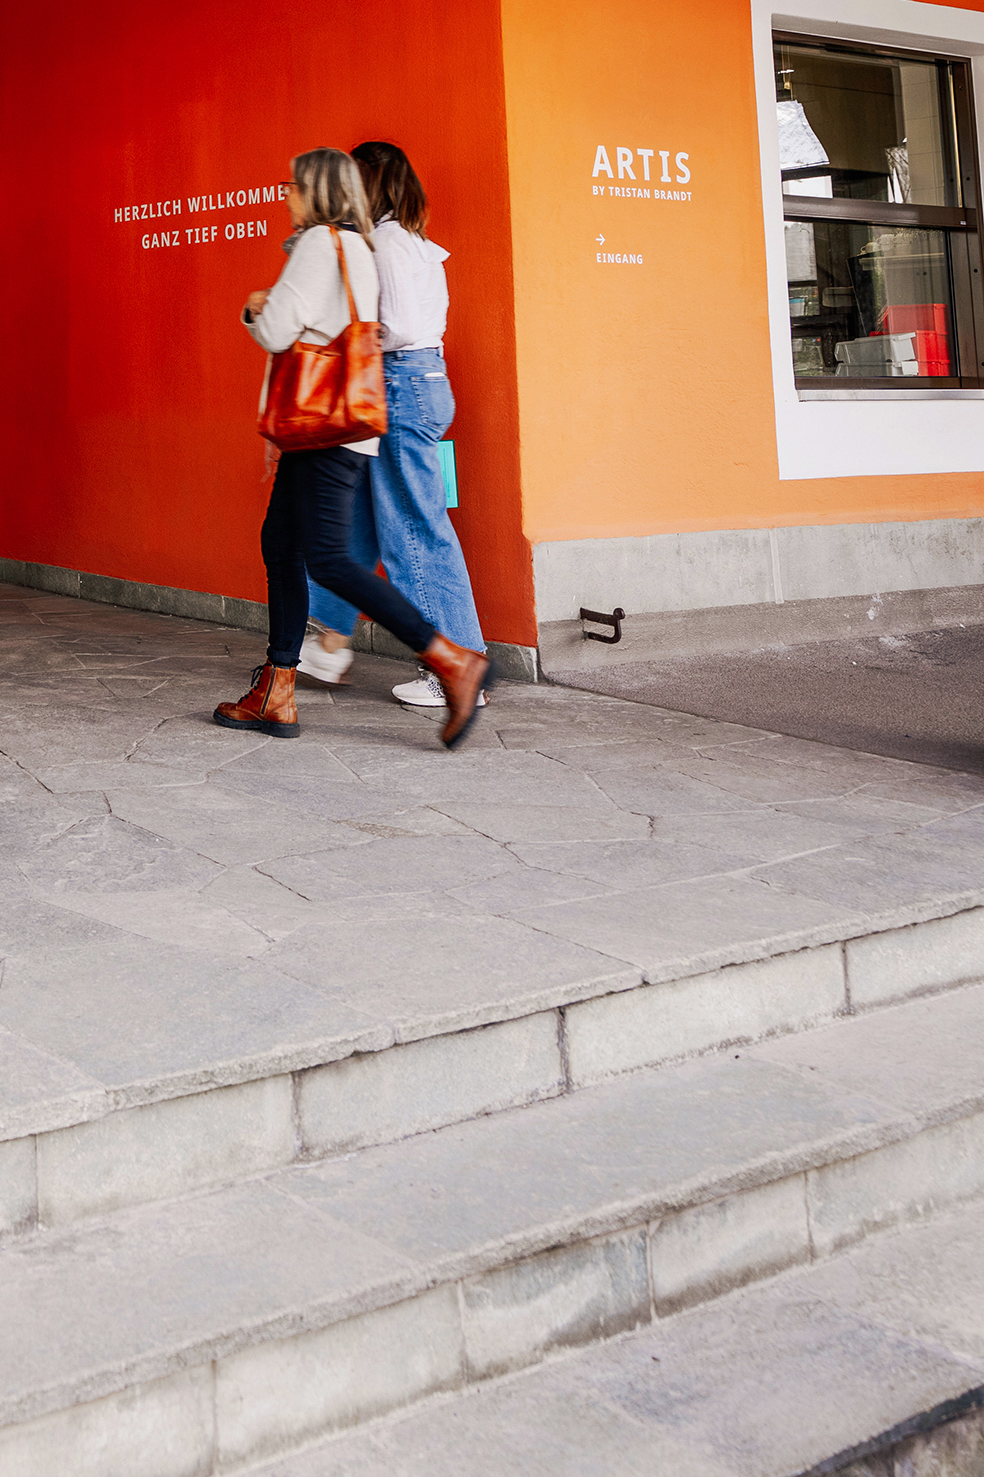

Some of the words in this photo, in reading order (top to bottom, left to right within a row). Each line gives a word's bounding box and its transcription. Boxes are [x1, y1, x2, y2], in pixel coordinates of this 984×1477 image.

[592, 145, 691, 184] ARTIS
[114, 199, 182, 223] HERZLICH
[187, 184, 286, 213] WILLKOMME
[592, 185, 605, 196] BY
[608, 186, 651, 199] TRISTAN
[654, 189, 692, 201] BRANDT
[141, 230, 180, 250] GANZ
[185, 225, 218, 245] TIEF
[224, 220, 268, 241] OBEN
[596, 252, 643, 265] EINGANG
